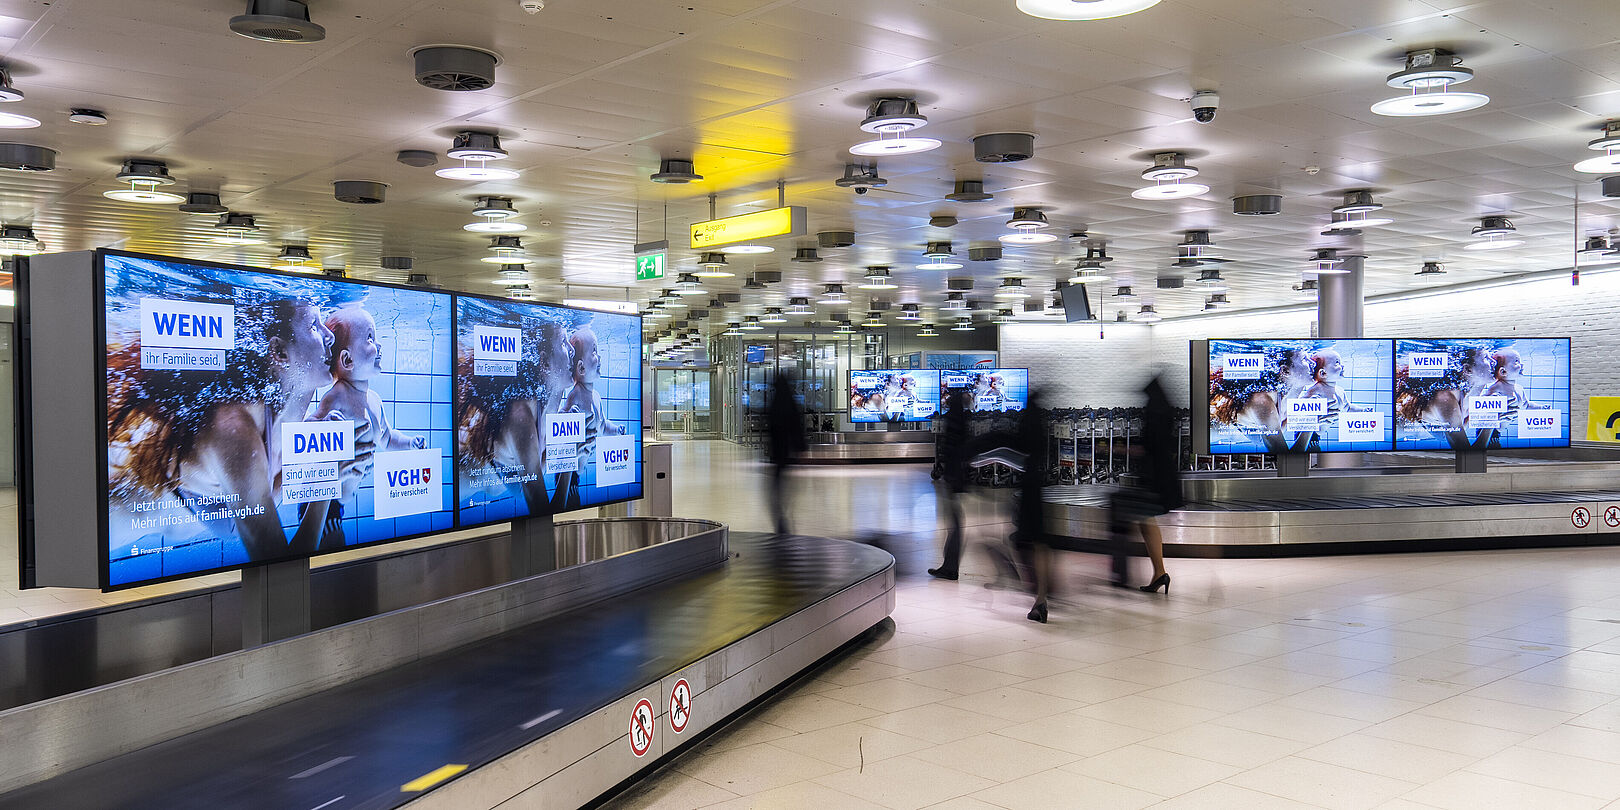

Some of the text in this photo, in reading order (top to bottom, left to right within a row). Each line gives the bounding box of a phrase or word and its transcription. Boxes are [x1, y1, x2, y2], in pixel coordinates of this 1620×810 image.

[705, 223, 727, 232] Ausgang
[153, 312, 223, 338] WENN
[480, 335, 515, 353] WENN
[146, 352, 221, 367] ihr Familie seid,
[1228, 358, 1259, 367] WENN
[1413, 357, 1443, 366] WENN
[485, 363, 502, 373] Familie
[1293, 403, 1321, 412] DANN
[1475, 400, 1502, 409] DANN
[1526, 418, 1547, 426] VGH
[552, 421, 580, 437] DANN
[294, 432, 344, 454] DANN
[603, 450, 623, 463] VGH
[286, 467, 335, 480] sind wir eure
[387, 468, 420, 487] VGH
[469, 468, 481, 477] Jetzt
[469, 480, 482, 488] Mehr
[504, 473, 537, 484] familie.vgh.de
[286, 486, 338, 500] Versicherung.
[390, 487, 428, 498] fair versichert
[131, 493, 242, 513] Jetzt rundum absichern.
[131, 505, 265, 530] Mehr Infos auf familie.vgh.de
